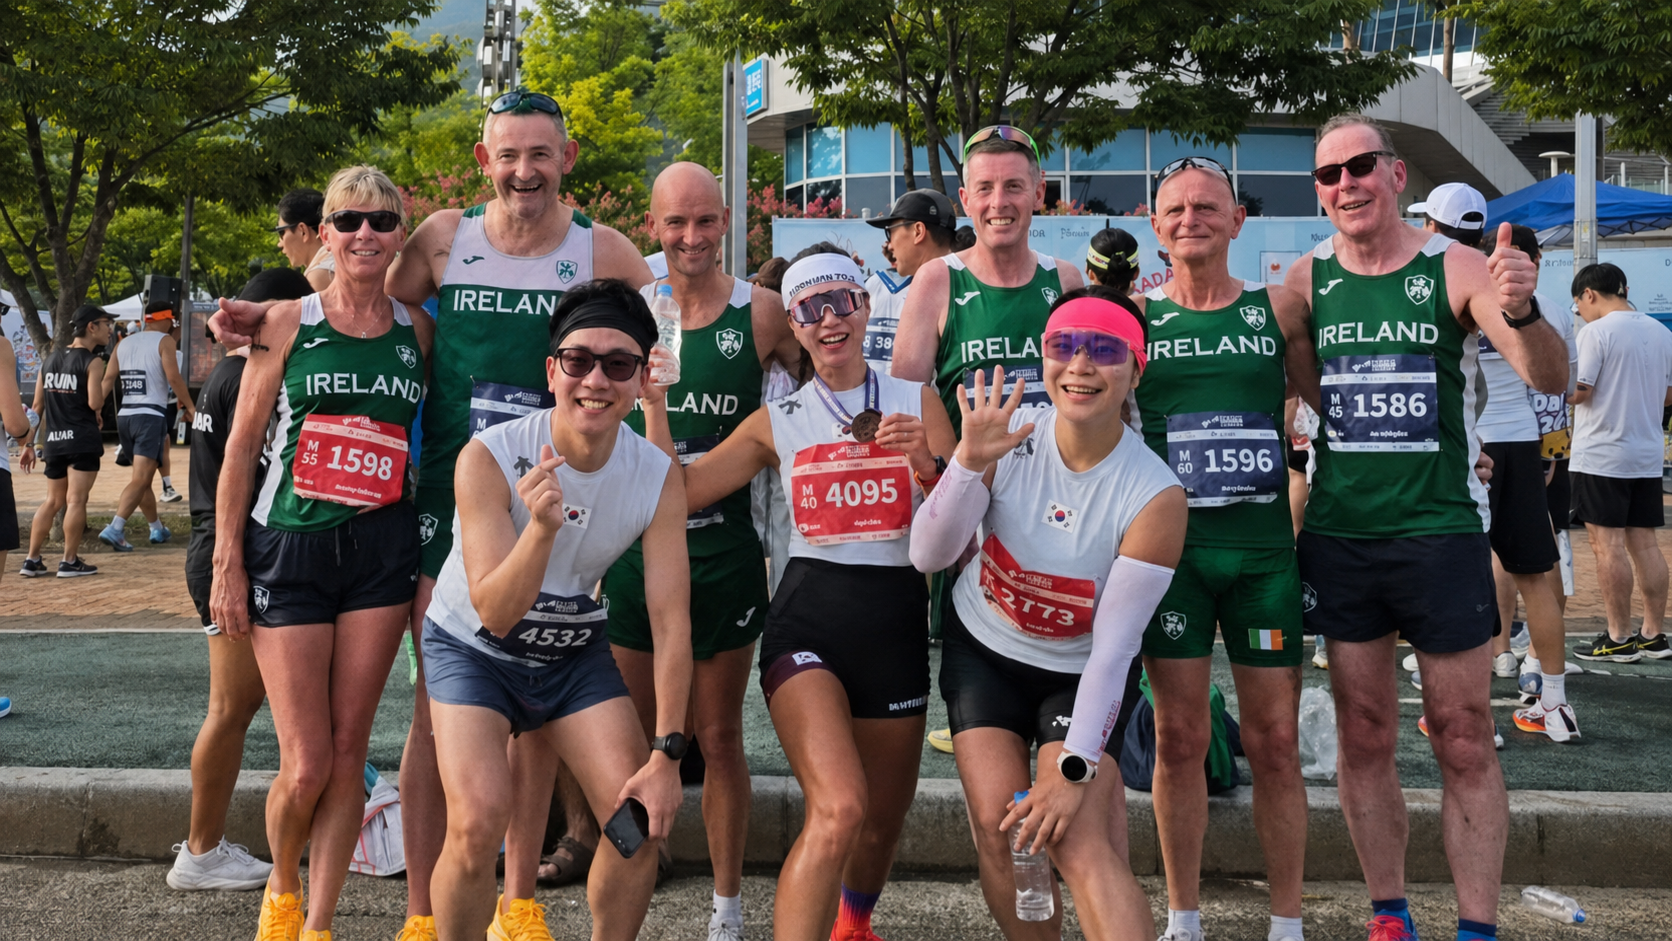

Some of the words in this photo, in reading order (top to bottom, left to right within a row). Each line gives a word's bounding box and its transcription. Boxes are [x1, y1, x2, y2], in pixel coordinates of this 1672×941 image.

[453, 289, 557, 317] IRELAN
[875, 336, 893, 349] 38
[1318, 321, 1439, 349] IRELAND
[961, 336, 1041, 363] IRELA
[1147, 335, 1276, 362] IRELAND
[306, 373, 421, 404] IRELAND
[1330, 393, 1341, 405] M
[1353, 392, 1428, 418] 1586
[1328, 406, 1343, 418] 45
[476, 418, 487, 430] M
[307, 439, 320, 452] M
[301, 452, 319, 465] 55
[326, 445, 393, 481] 1598
[1179, 450, 1191, 462] M
[1204, 448, 1274, 473] 1596
[1177, 463, 1193, 474] 60
[802, 484, 814, 496] M
[825, 478, 898, 508] 4095
[800, 496, 818, 509] 40
[518, 627, 592, 647] 4532
